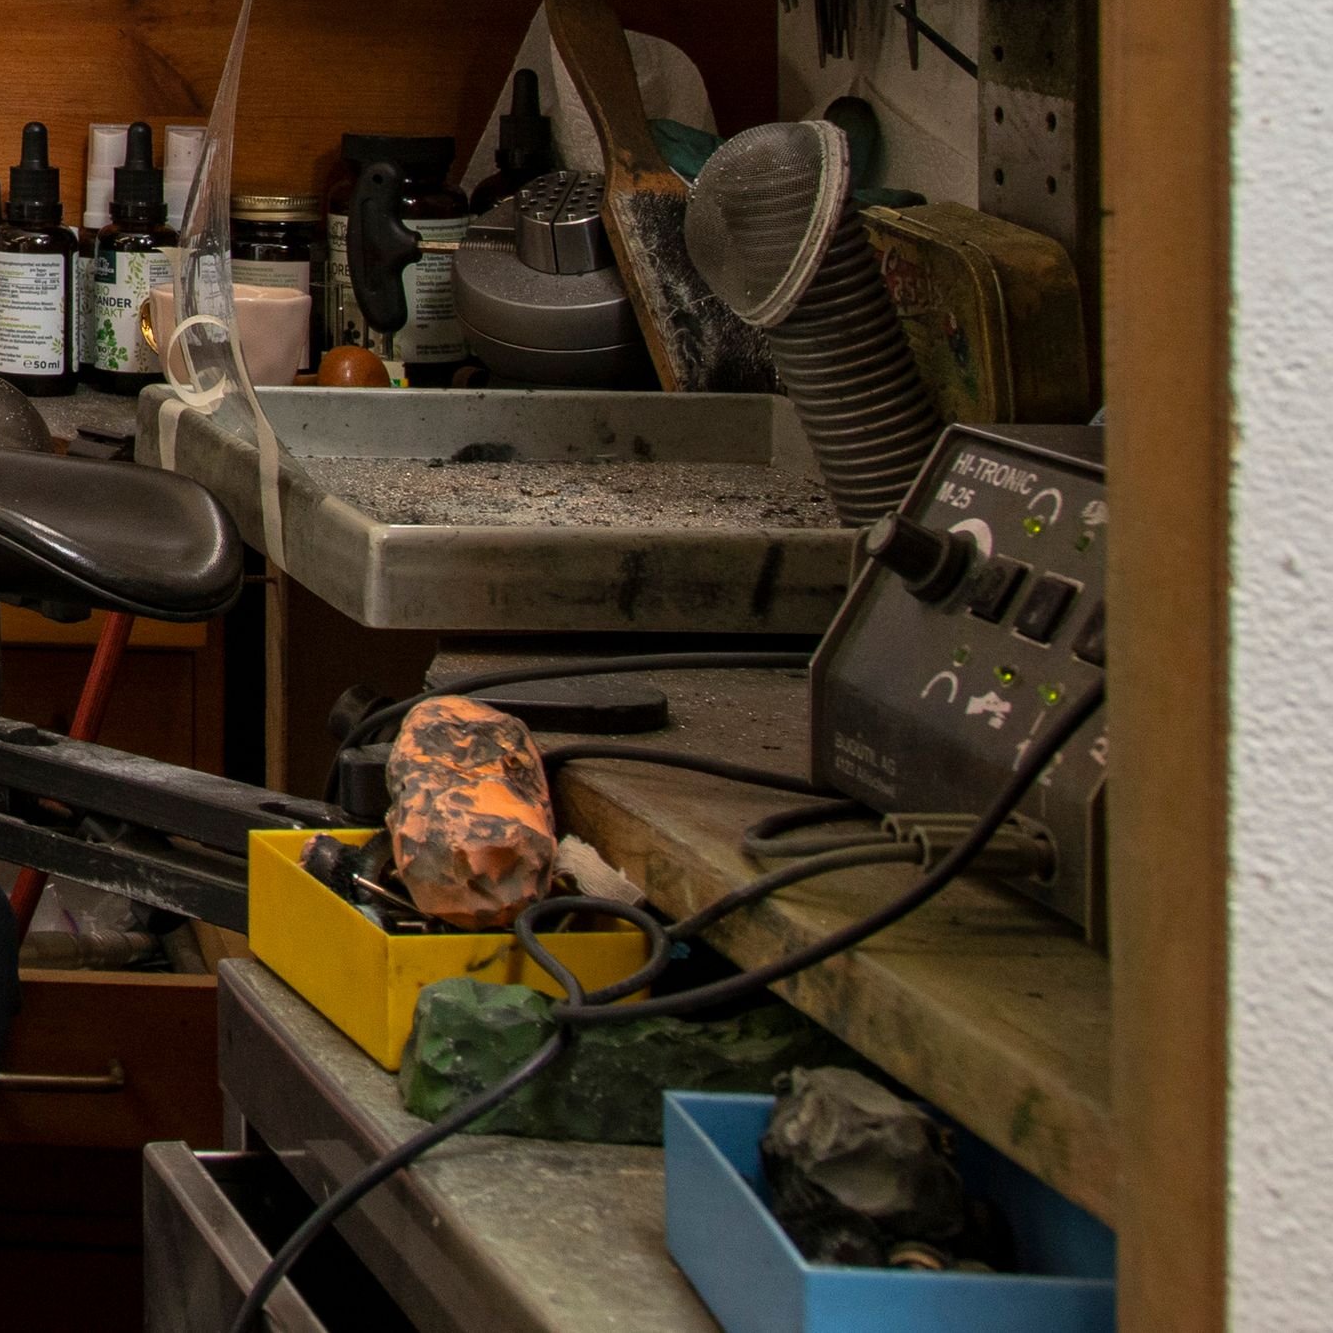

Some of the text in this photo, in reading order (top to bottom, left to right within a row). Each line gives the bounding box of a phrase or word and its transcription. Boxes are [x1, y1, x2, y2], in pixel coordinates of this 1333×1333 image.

[95, 295, 132, 308] ANDER
[34, 360, 60, 369] 50 ml
[951, 452, 1038, 496] HI-TRONIC
[935, 481, 976, 510] M-25
